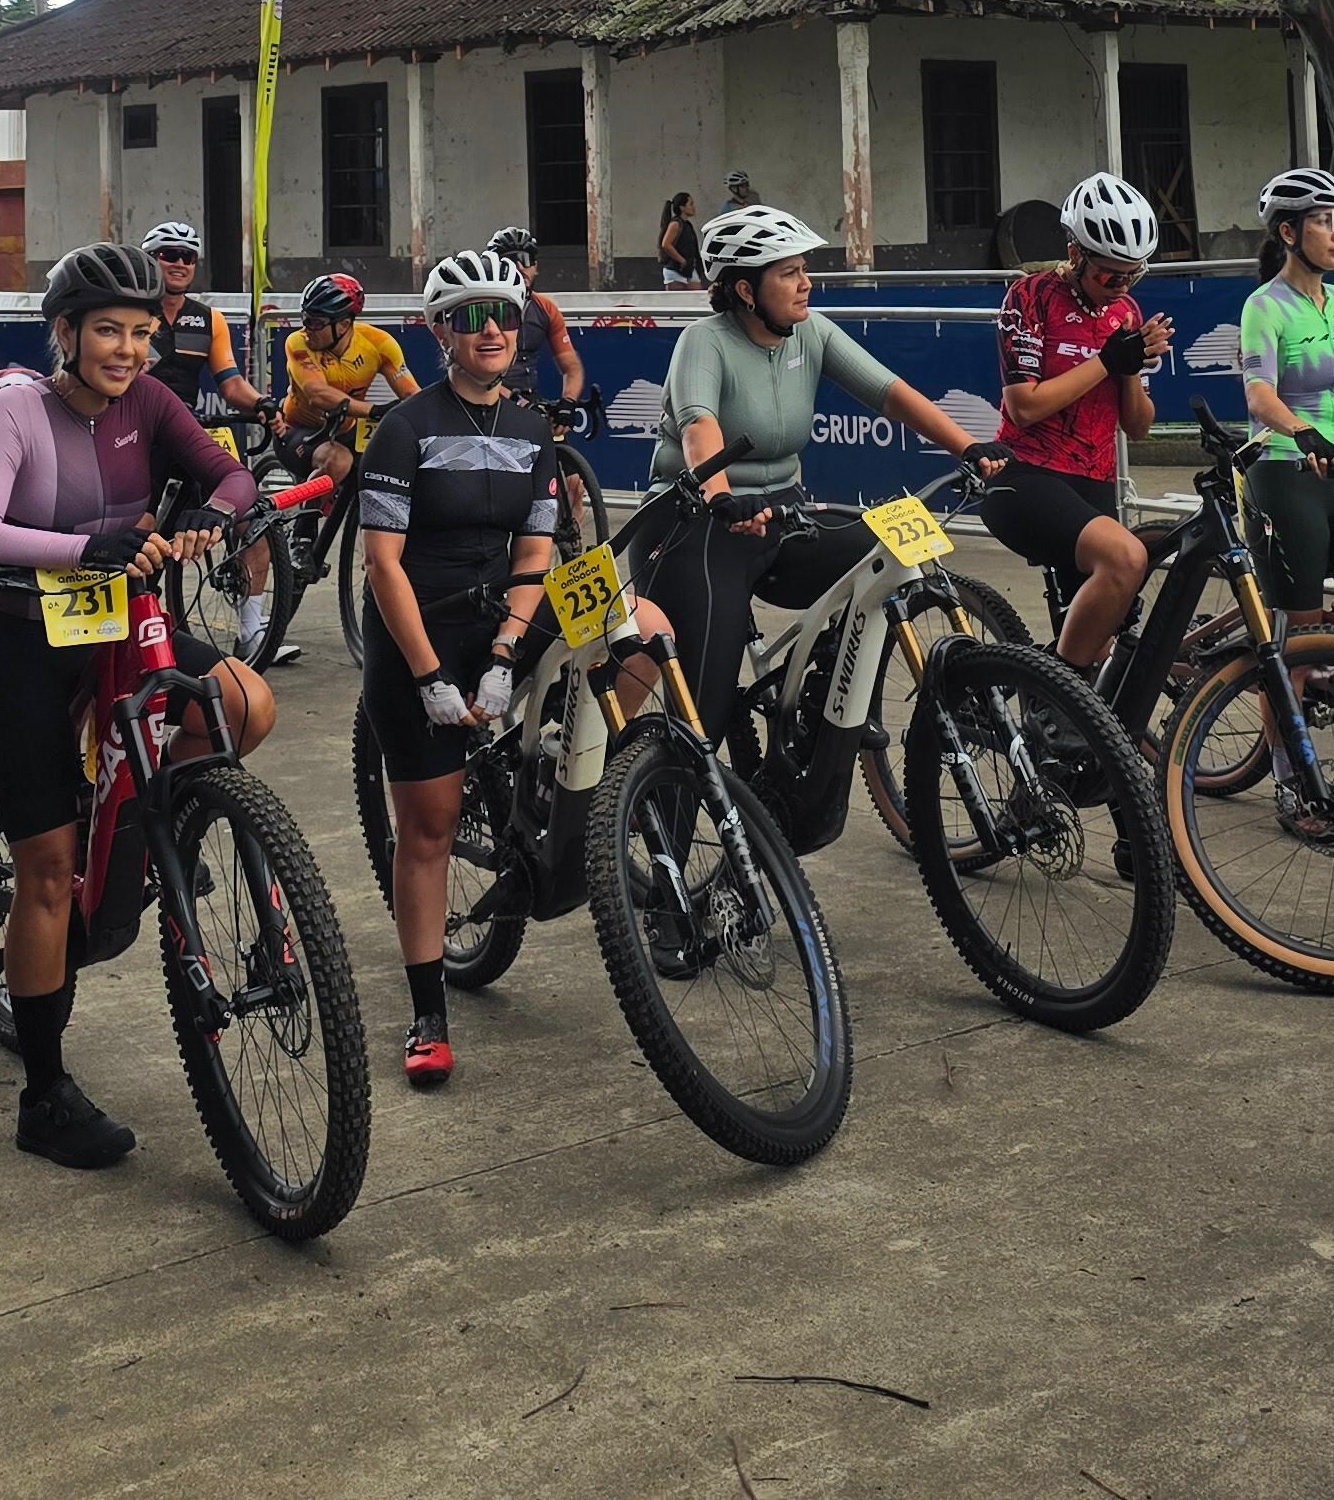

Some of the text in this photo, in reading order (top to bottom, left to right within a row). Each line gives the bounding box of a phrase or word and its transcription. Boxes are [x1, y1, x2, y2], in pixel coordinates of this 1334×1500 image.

[809, 412, 893, 447] GRUPO
[886, 517, 936, 547] 232
[560, 564, 601, 590] ambacar
[60, 583, 114, 618] 231
[563, 576, 612, 621] 233
[831, 608, 868, 722] S-WORKS
[810, 910, 839, 991] ELIMINATOR
